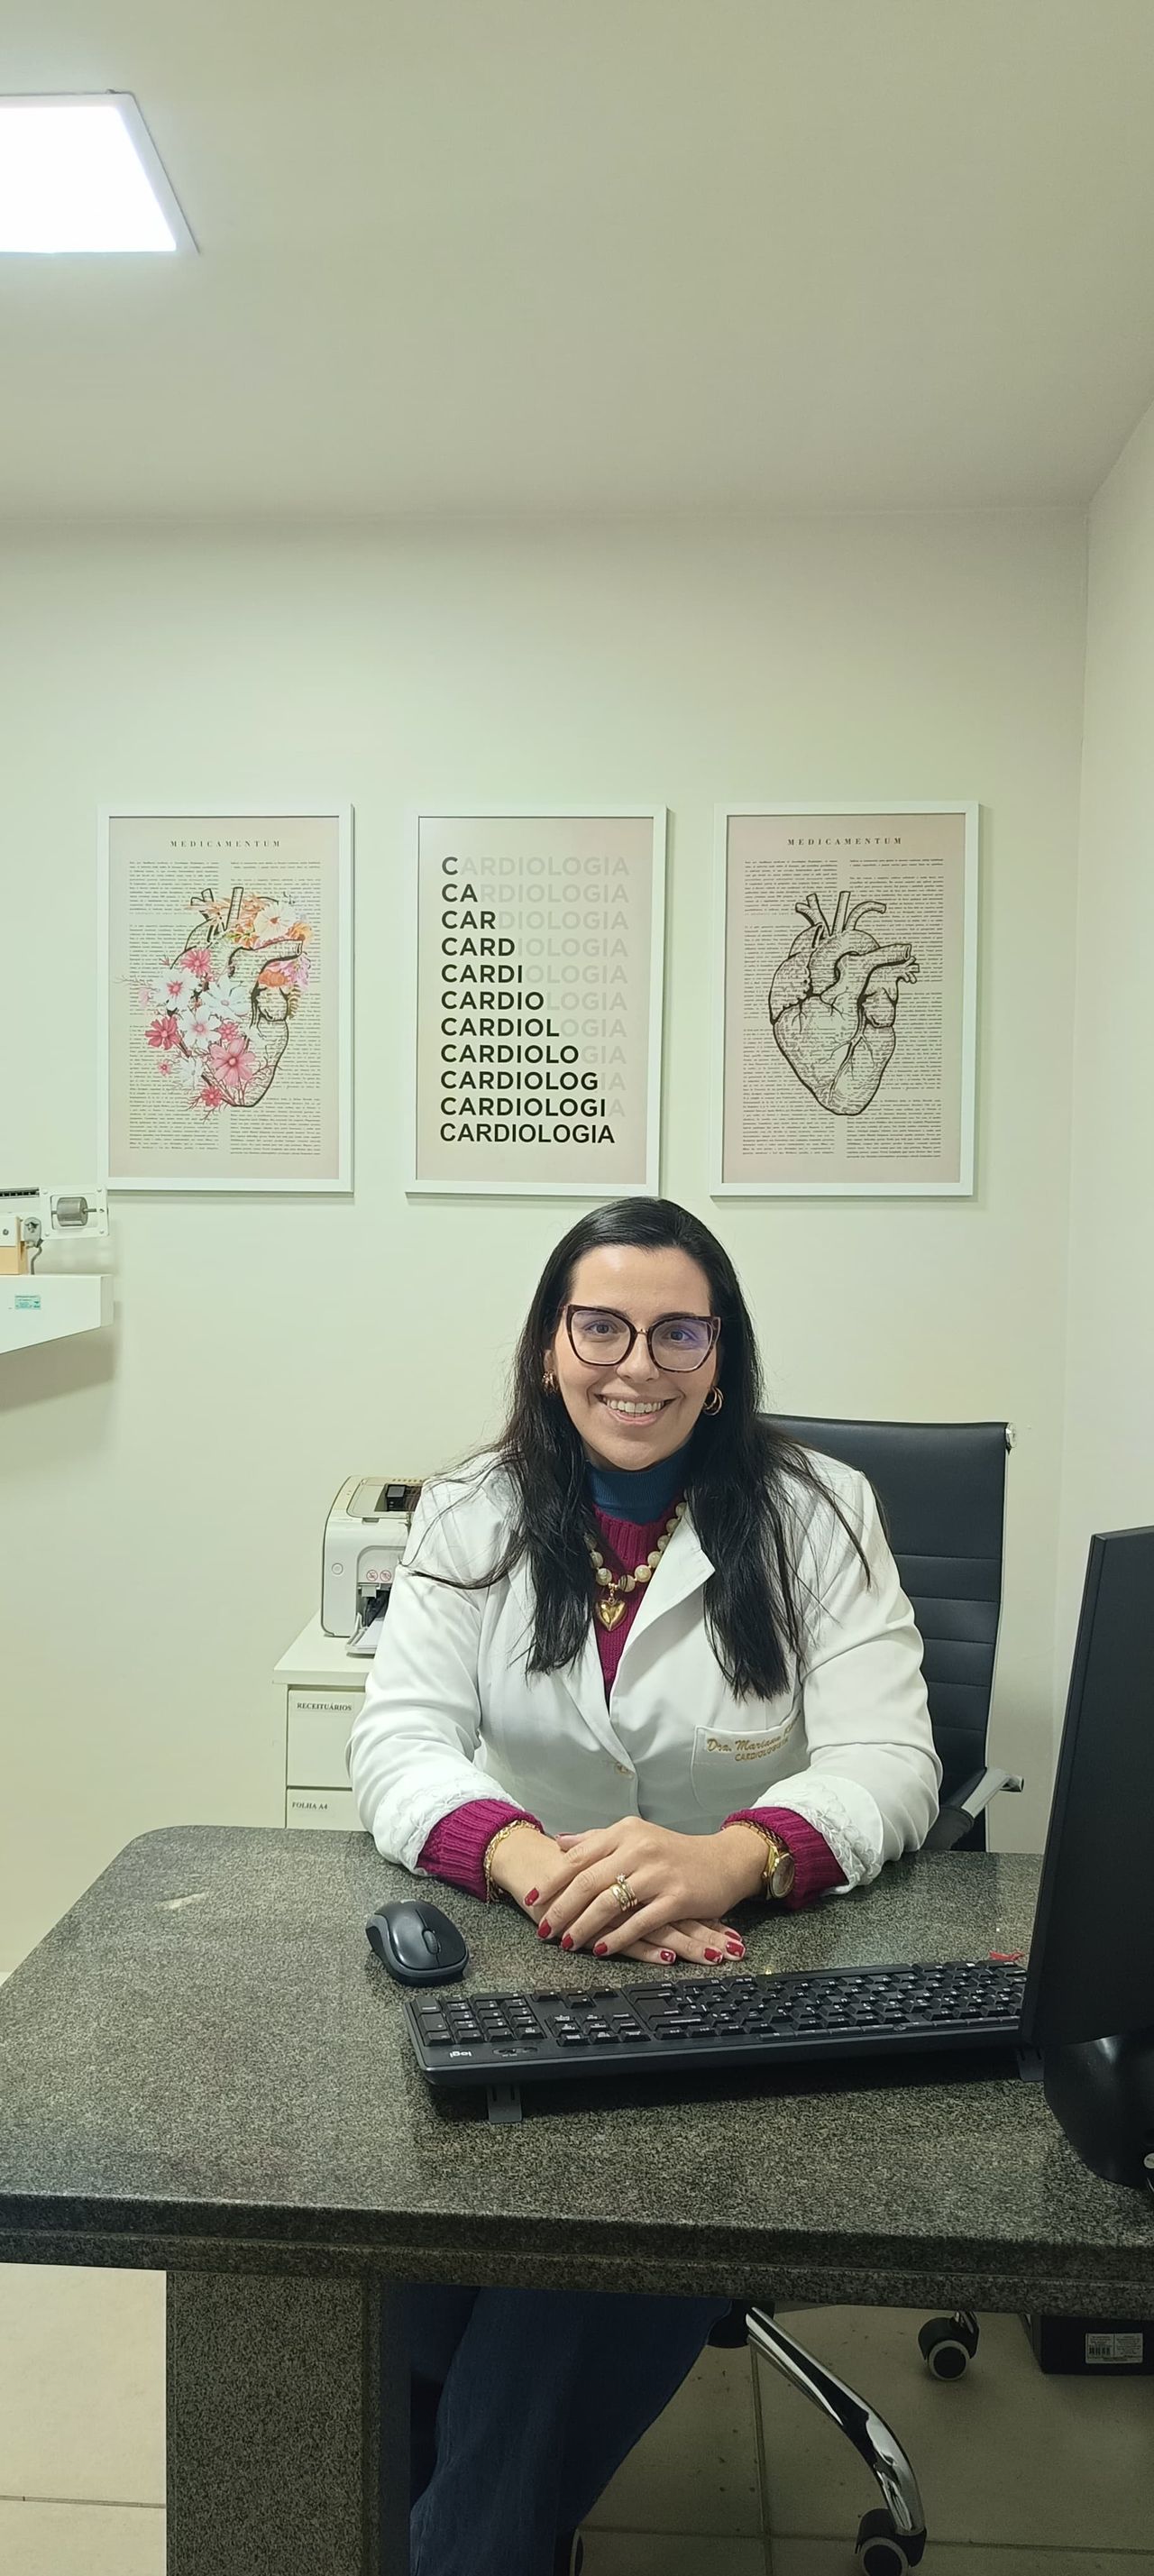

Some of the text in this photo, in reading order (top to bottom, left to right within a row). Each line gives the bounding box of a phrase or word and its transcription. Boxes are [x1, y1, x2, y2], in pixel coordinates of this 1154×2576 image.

[787, 838, 902, 846] MEDICAMENTUM
[441, 1070, 626, 1091] CARDIOLOGIA
[440, 1096, 626, 1117] CARDIOLOGIA
[440, 1123, 615, 1143] CARDIOLOGIA
[297, 1702, 352, 1711] RECEITUÁRIOS
[707, 1737, 732, 1752] Dra.
[292, 1801, 317, 1810] FOLHA
[449, 2050, 472, 2058] logi
